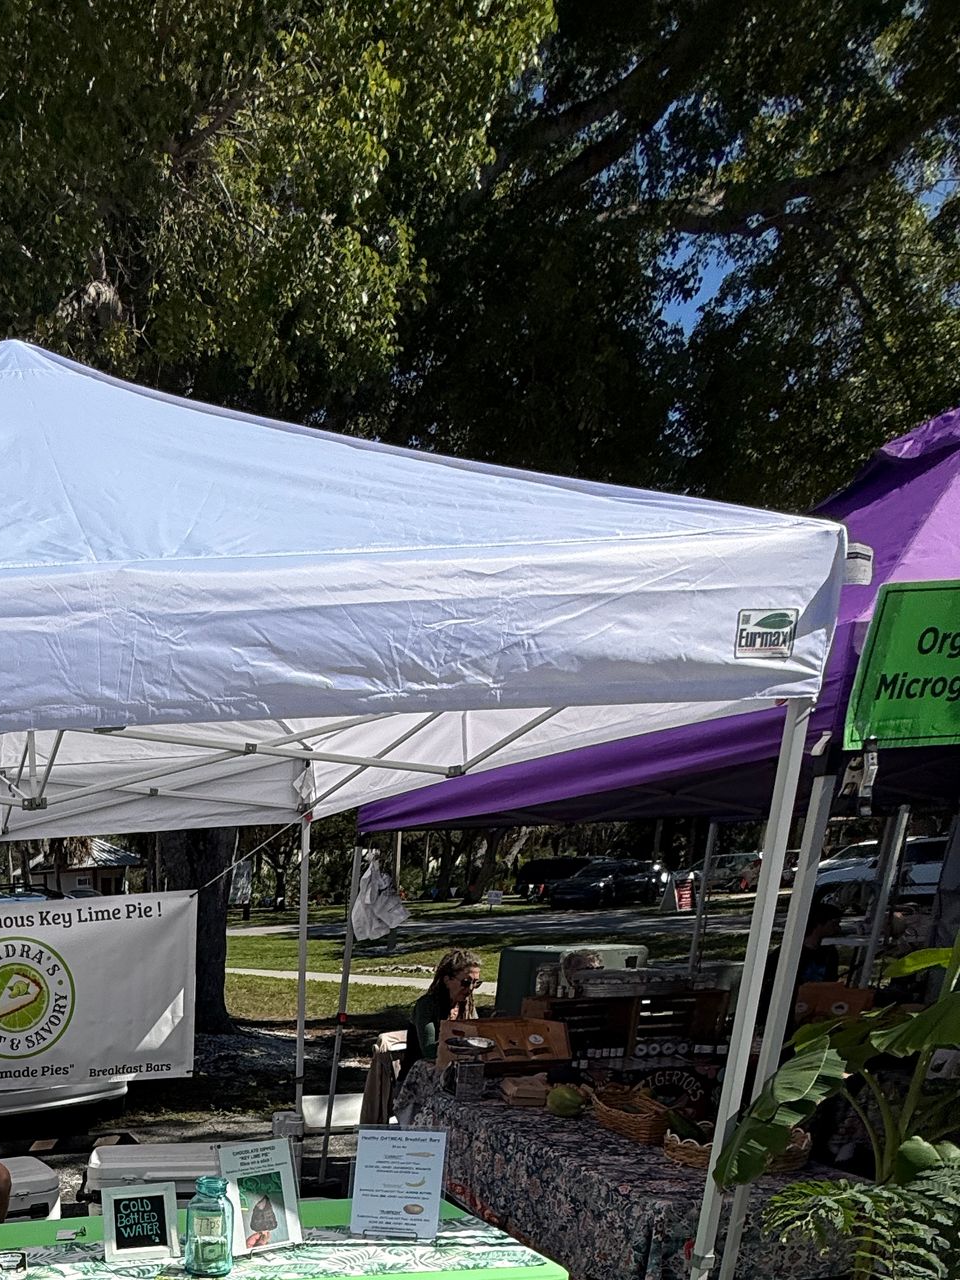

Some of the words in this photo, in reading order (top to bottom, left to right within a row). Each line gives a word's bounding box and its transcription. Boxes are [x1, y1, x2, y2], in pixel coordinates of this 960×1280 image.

[738, 628, 788, 648] Eurmax
[874, 671, 960, 702] Microg
[38, 910, 73, 928] Key
[76, 906, 121, 923] Lime
[124, 902, 153, 919] Pie
[9, 1038, 21, 1051] &
[25, 991, 68, 1049] SAVORY
[89, 1063, 144, 1078] Breakfast
[145, 1062, 172, 1073] Bars
[120, 1199, 152, 1214] COLD
[120, 1222, 161, 1238] WATER
